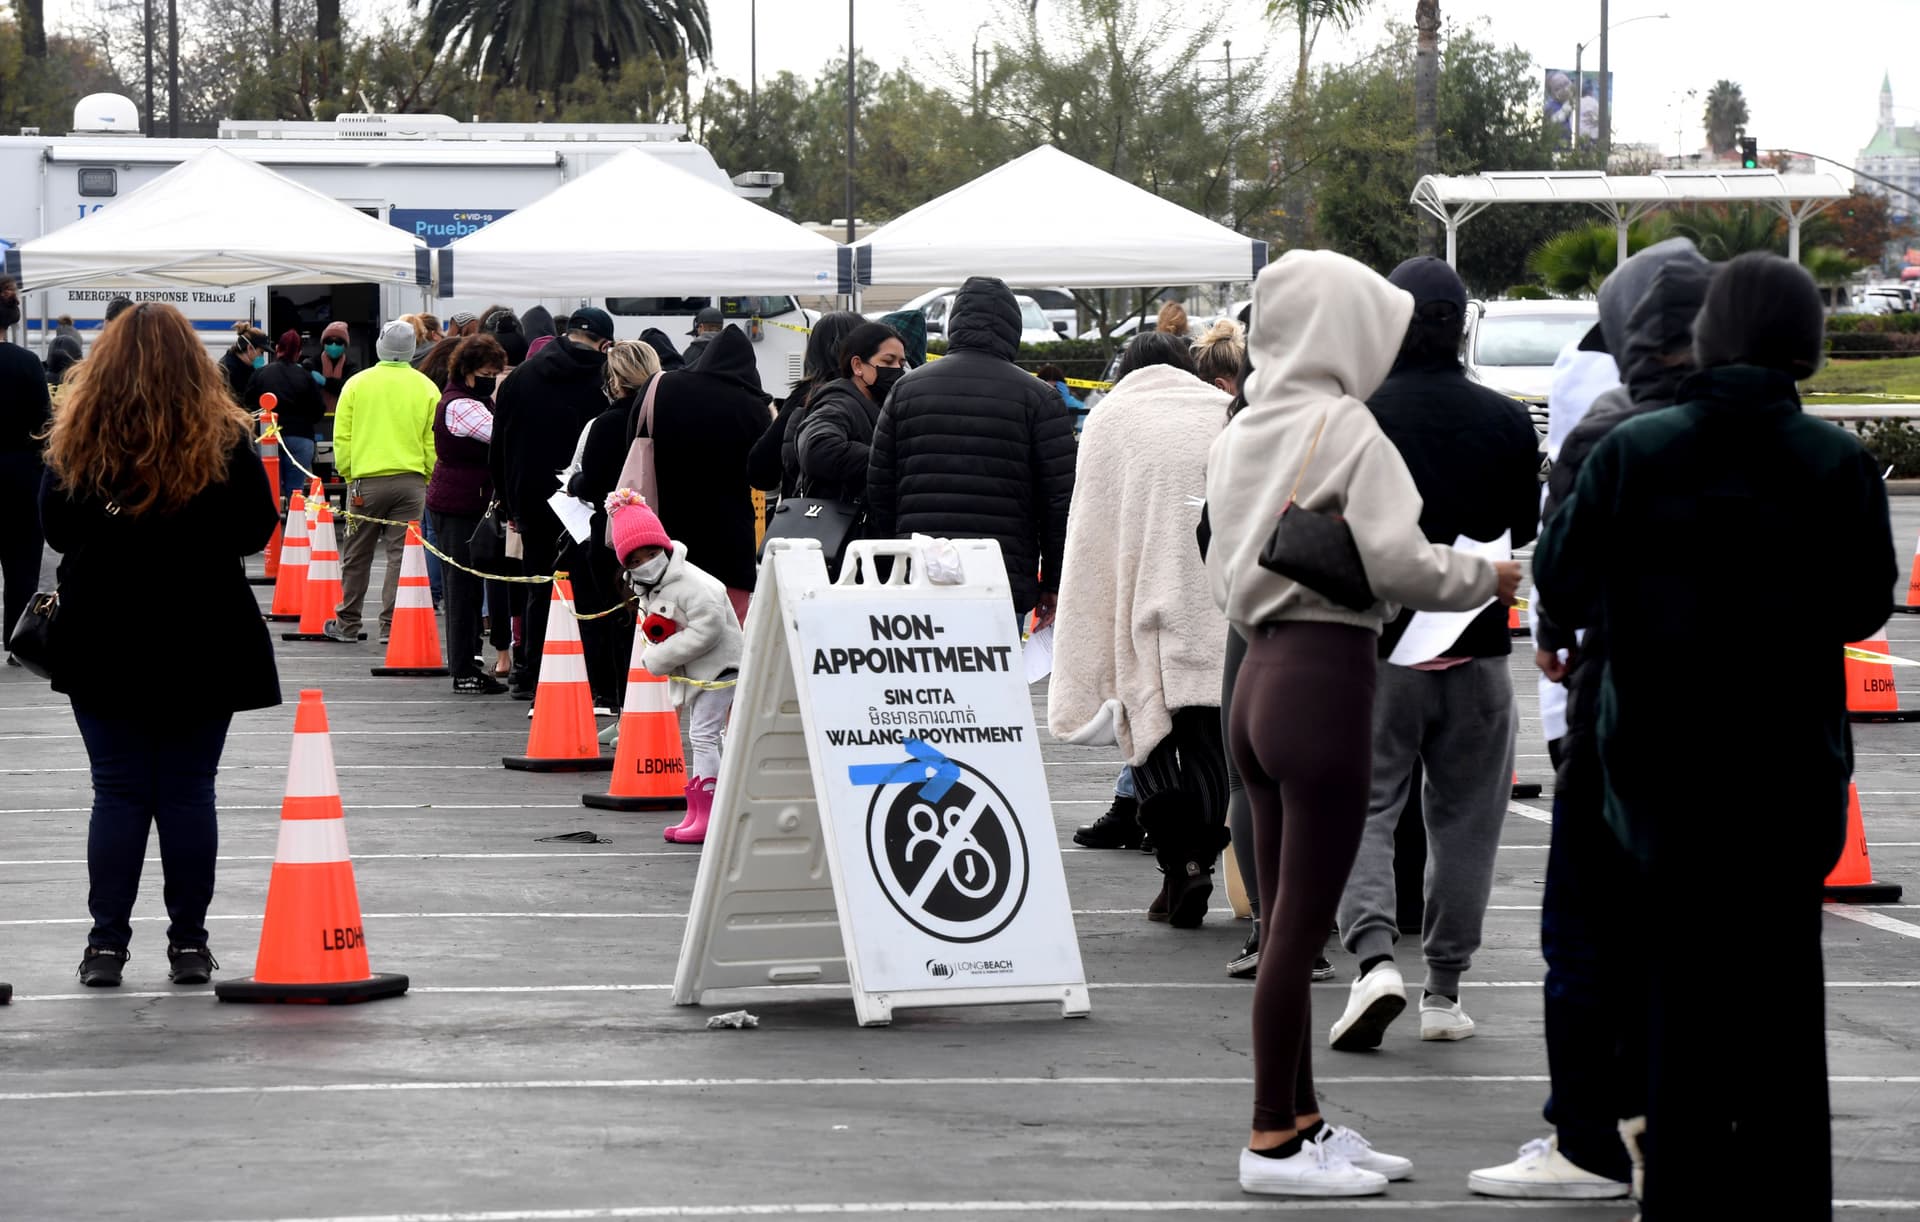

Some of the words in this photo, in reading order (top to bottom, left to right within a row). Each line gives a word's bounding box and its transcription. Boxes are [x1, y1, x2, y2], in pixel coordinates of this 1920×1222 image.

[415, 221, 478, 236] Prueba
[68, 290, 131, 302] EMERGENCY
[135, 292, 188, 303] RESPONSE
[192, 292, 236, 303] VEHICLE
[869, 614, 945, 641] NON-
[813, 646, 1011, 674] APPOINTMENT
[884, 689, 913, 705] SIN
[915, 688, 956, 704] CITA
[826, 729, 904, 746] WALANG
[637, 758, 684, 774] LBDHHS
